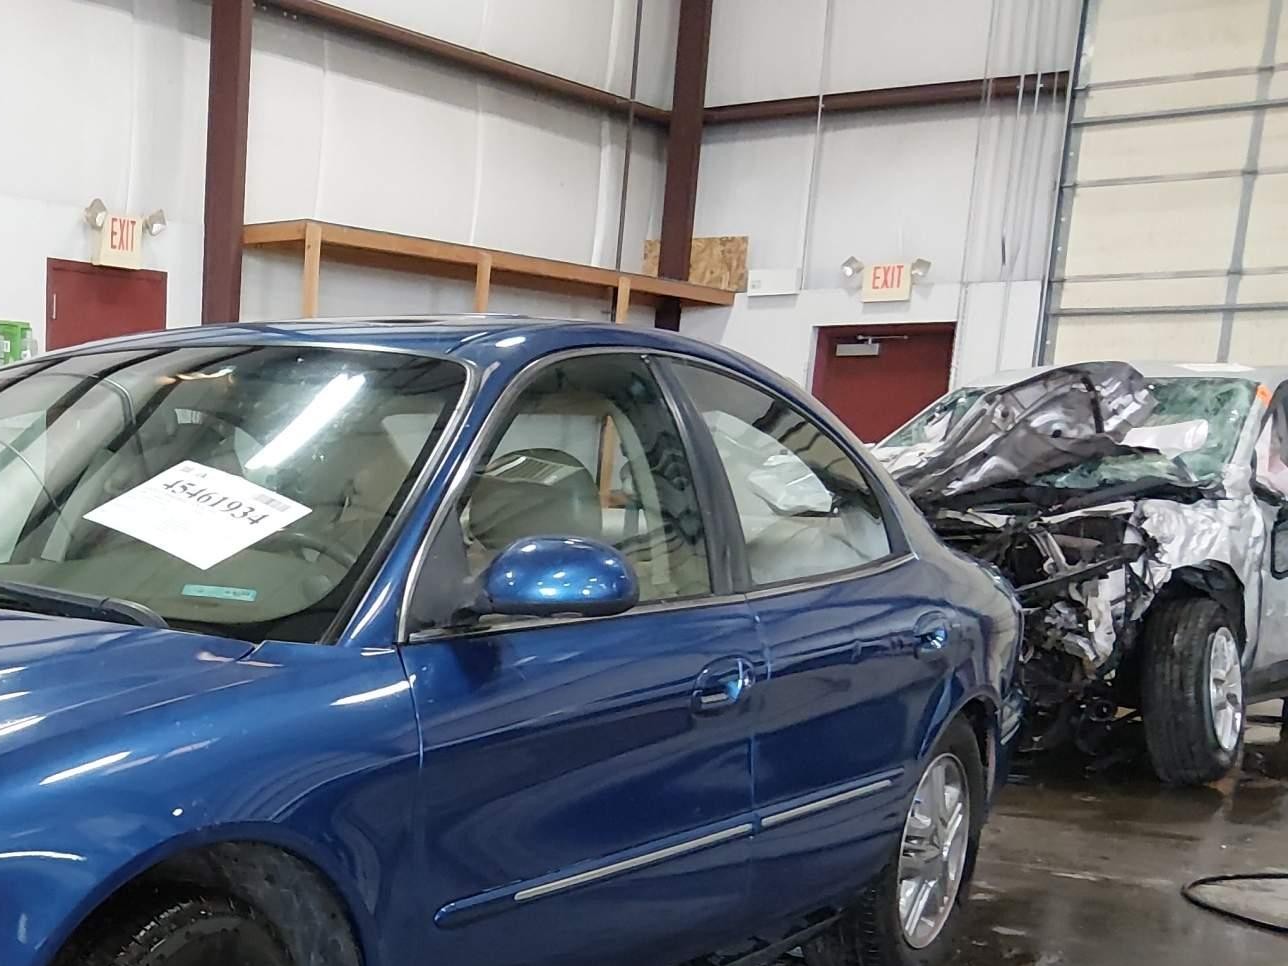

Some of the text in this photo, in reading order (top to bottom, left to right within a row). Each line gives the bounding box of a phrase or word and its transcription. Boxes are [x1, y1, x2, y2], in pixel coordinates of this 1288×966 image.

[110, 217, 137, 252] EXIT
[872, 265, 905, 289] EXIT
[163, 479, 269, 525] 45461934
